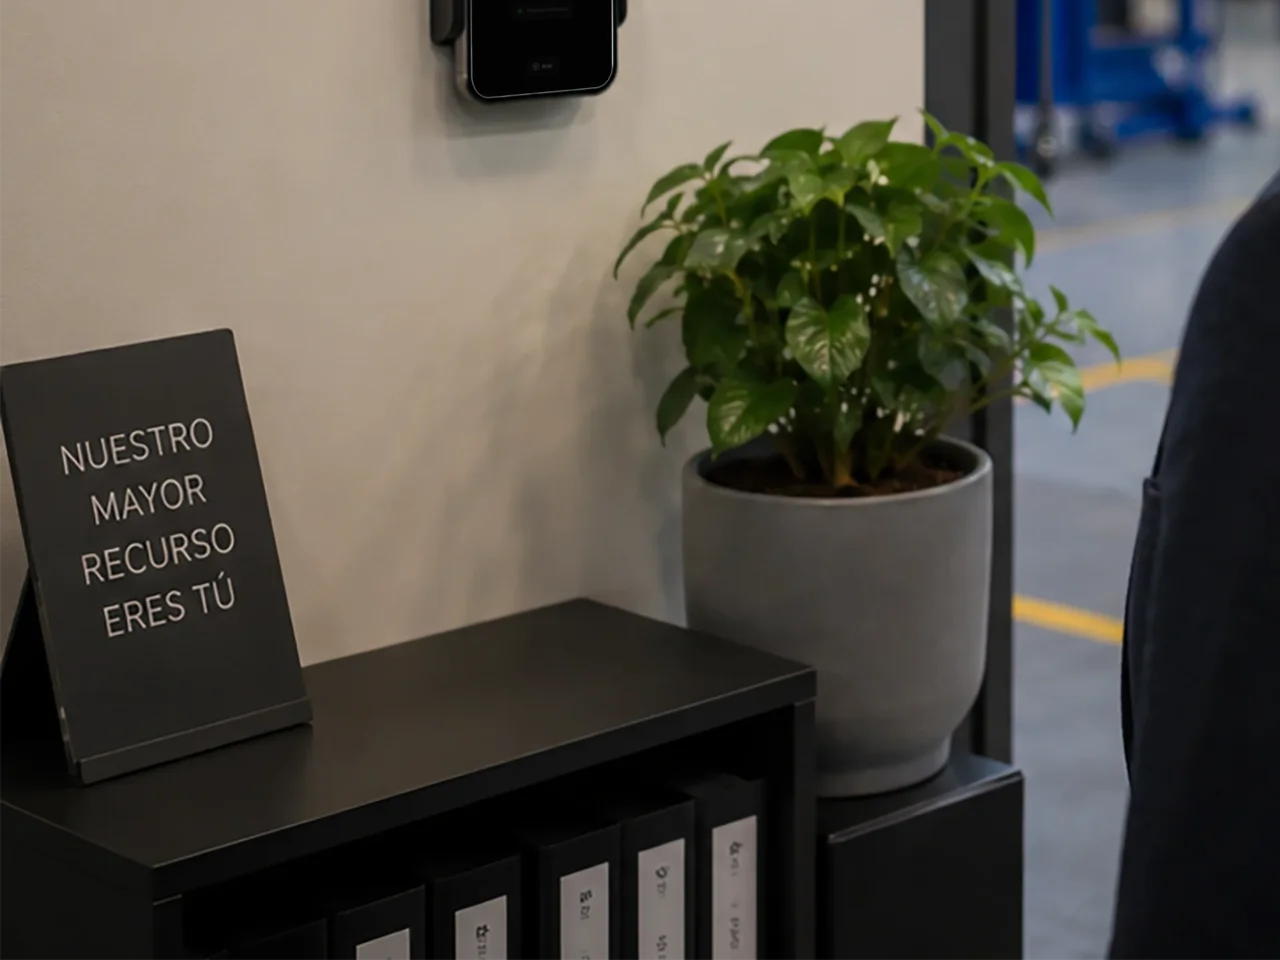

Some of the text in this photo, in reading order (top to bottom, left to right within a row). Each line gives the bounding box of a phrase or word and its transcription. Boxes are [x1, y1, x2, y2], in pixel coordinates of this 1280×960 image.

[60, 418, 213, 475] NUESTRO
[91, 474, 206, 525] MAYOR
[81, 523, 235, 585] RECURSO
[104, 572, 234, 636] ERES TÚ
